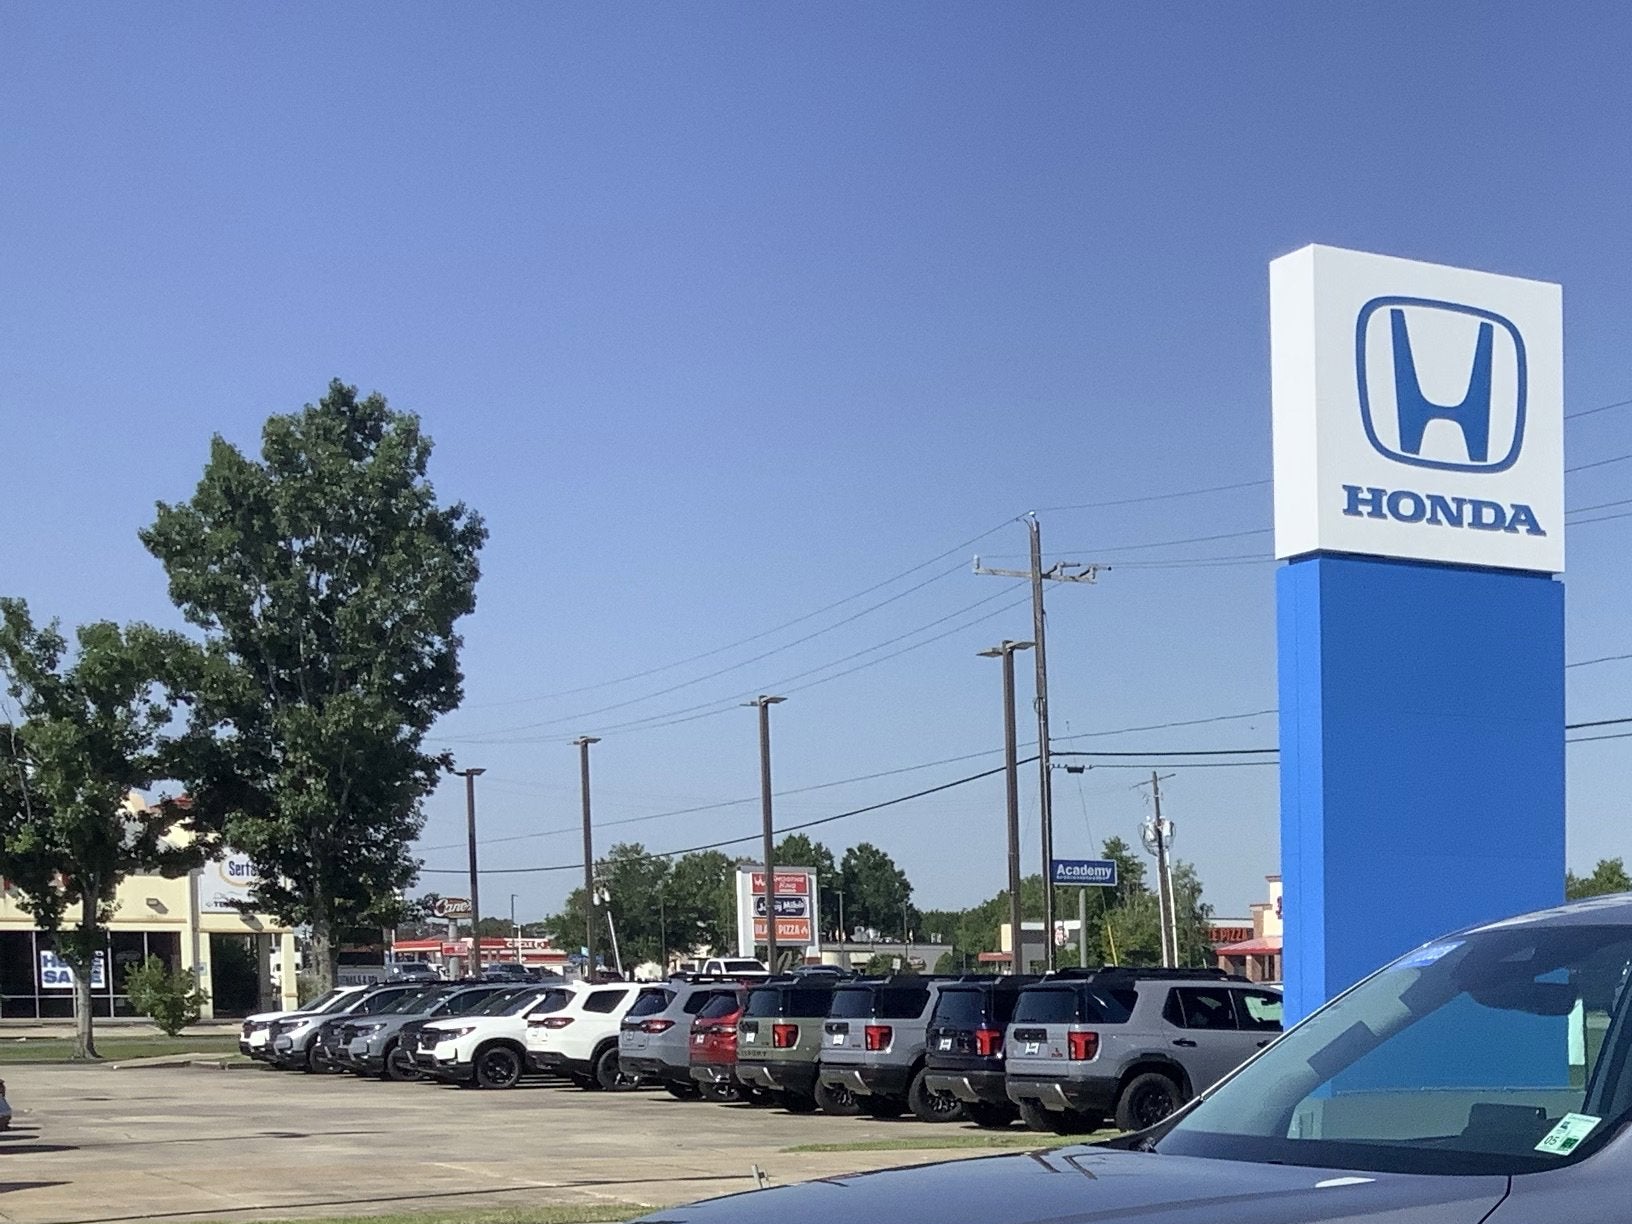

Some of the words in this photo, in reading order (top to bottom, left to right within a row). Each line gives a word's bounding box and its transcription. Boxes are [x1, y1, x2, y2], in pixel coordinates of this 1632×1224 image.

[1342, 485, 1547, 537] HONDA
[1056, 863, 1112, 880] Academy
[779, 924, 800, 936] PIZZA
